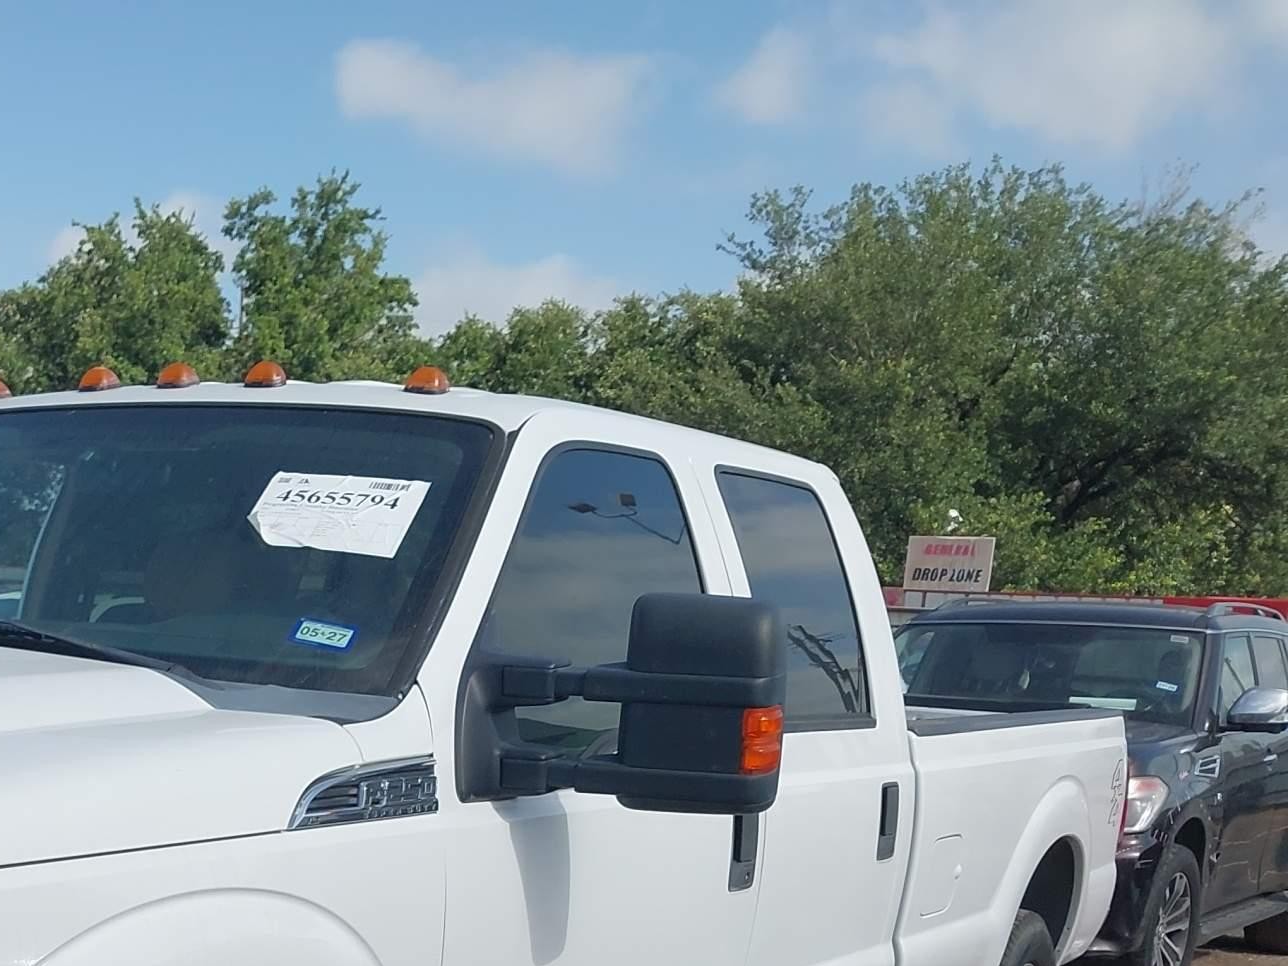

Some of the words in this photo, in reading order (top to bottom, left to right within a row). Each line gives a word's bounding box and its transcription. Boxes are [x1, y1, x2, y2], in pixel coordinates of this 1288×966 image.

[276, 489, 401, 509] 45655794
[912, 567, 948, 582] DROP
[948, 568, 983, 583] ZONE
